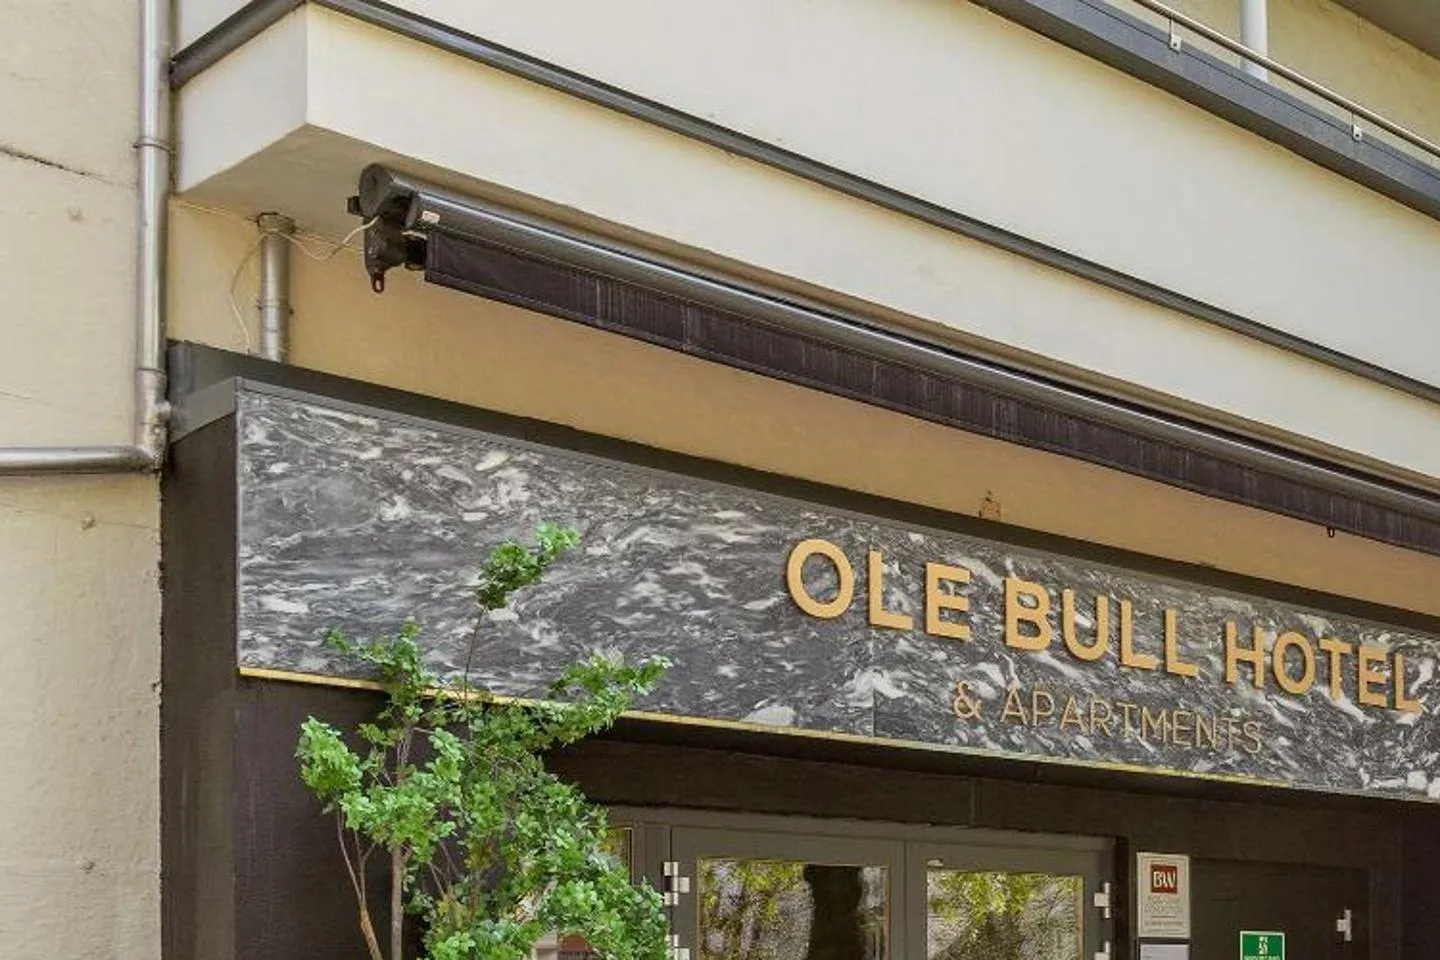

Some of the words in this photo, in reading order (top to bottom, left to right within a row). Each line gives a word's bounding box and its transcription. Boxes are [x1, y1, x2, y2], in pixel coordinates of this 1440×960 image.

[786, 538, 971, 641] OLE
[1006, 576, 1199, 677] BULL
[1226, 621, 1421, 713] HOTEL
[954, 680, 982, 720] &
[1000, 683, 1262, 753] APARTMENTS
[1153, 870, 1176, 888] BW
